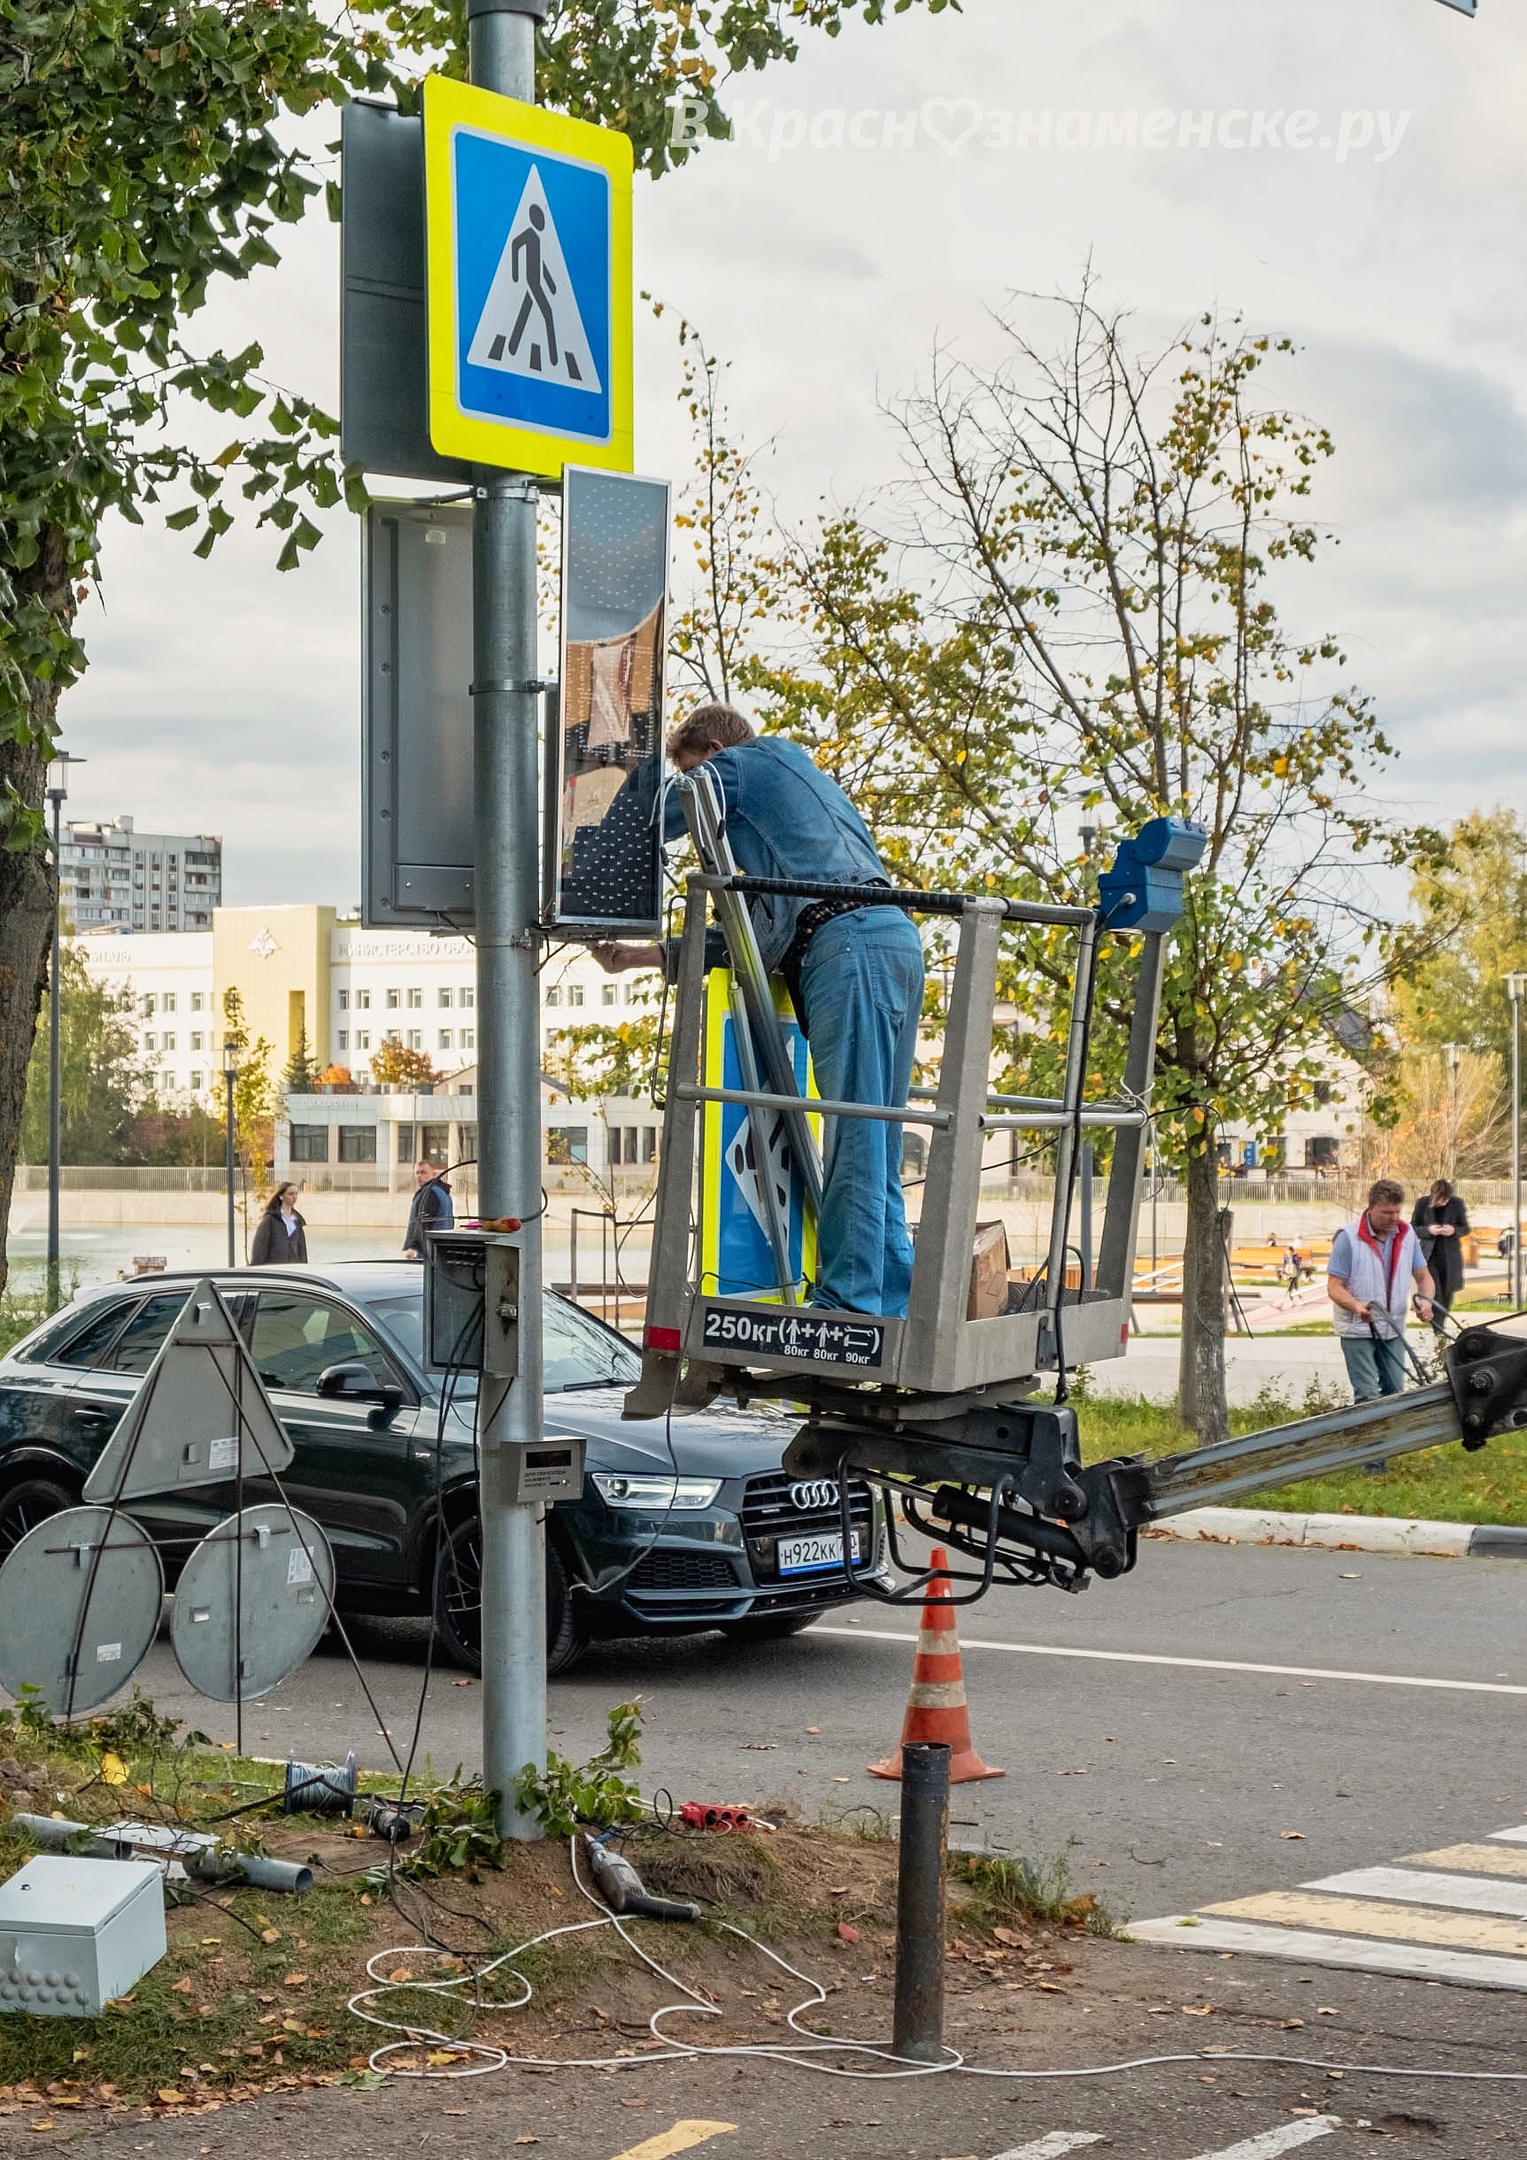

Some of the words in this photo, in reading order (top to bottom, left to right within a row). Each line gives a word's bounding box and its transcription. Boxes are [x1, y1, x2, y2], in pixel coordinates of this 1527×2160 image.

[784, 1344, 810, 1358] 80кг
[813, 1348, 839, 1362] 80кг
[845, 1351, 871, 1366] 90кг
